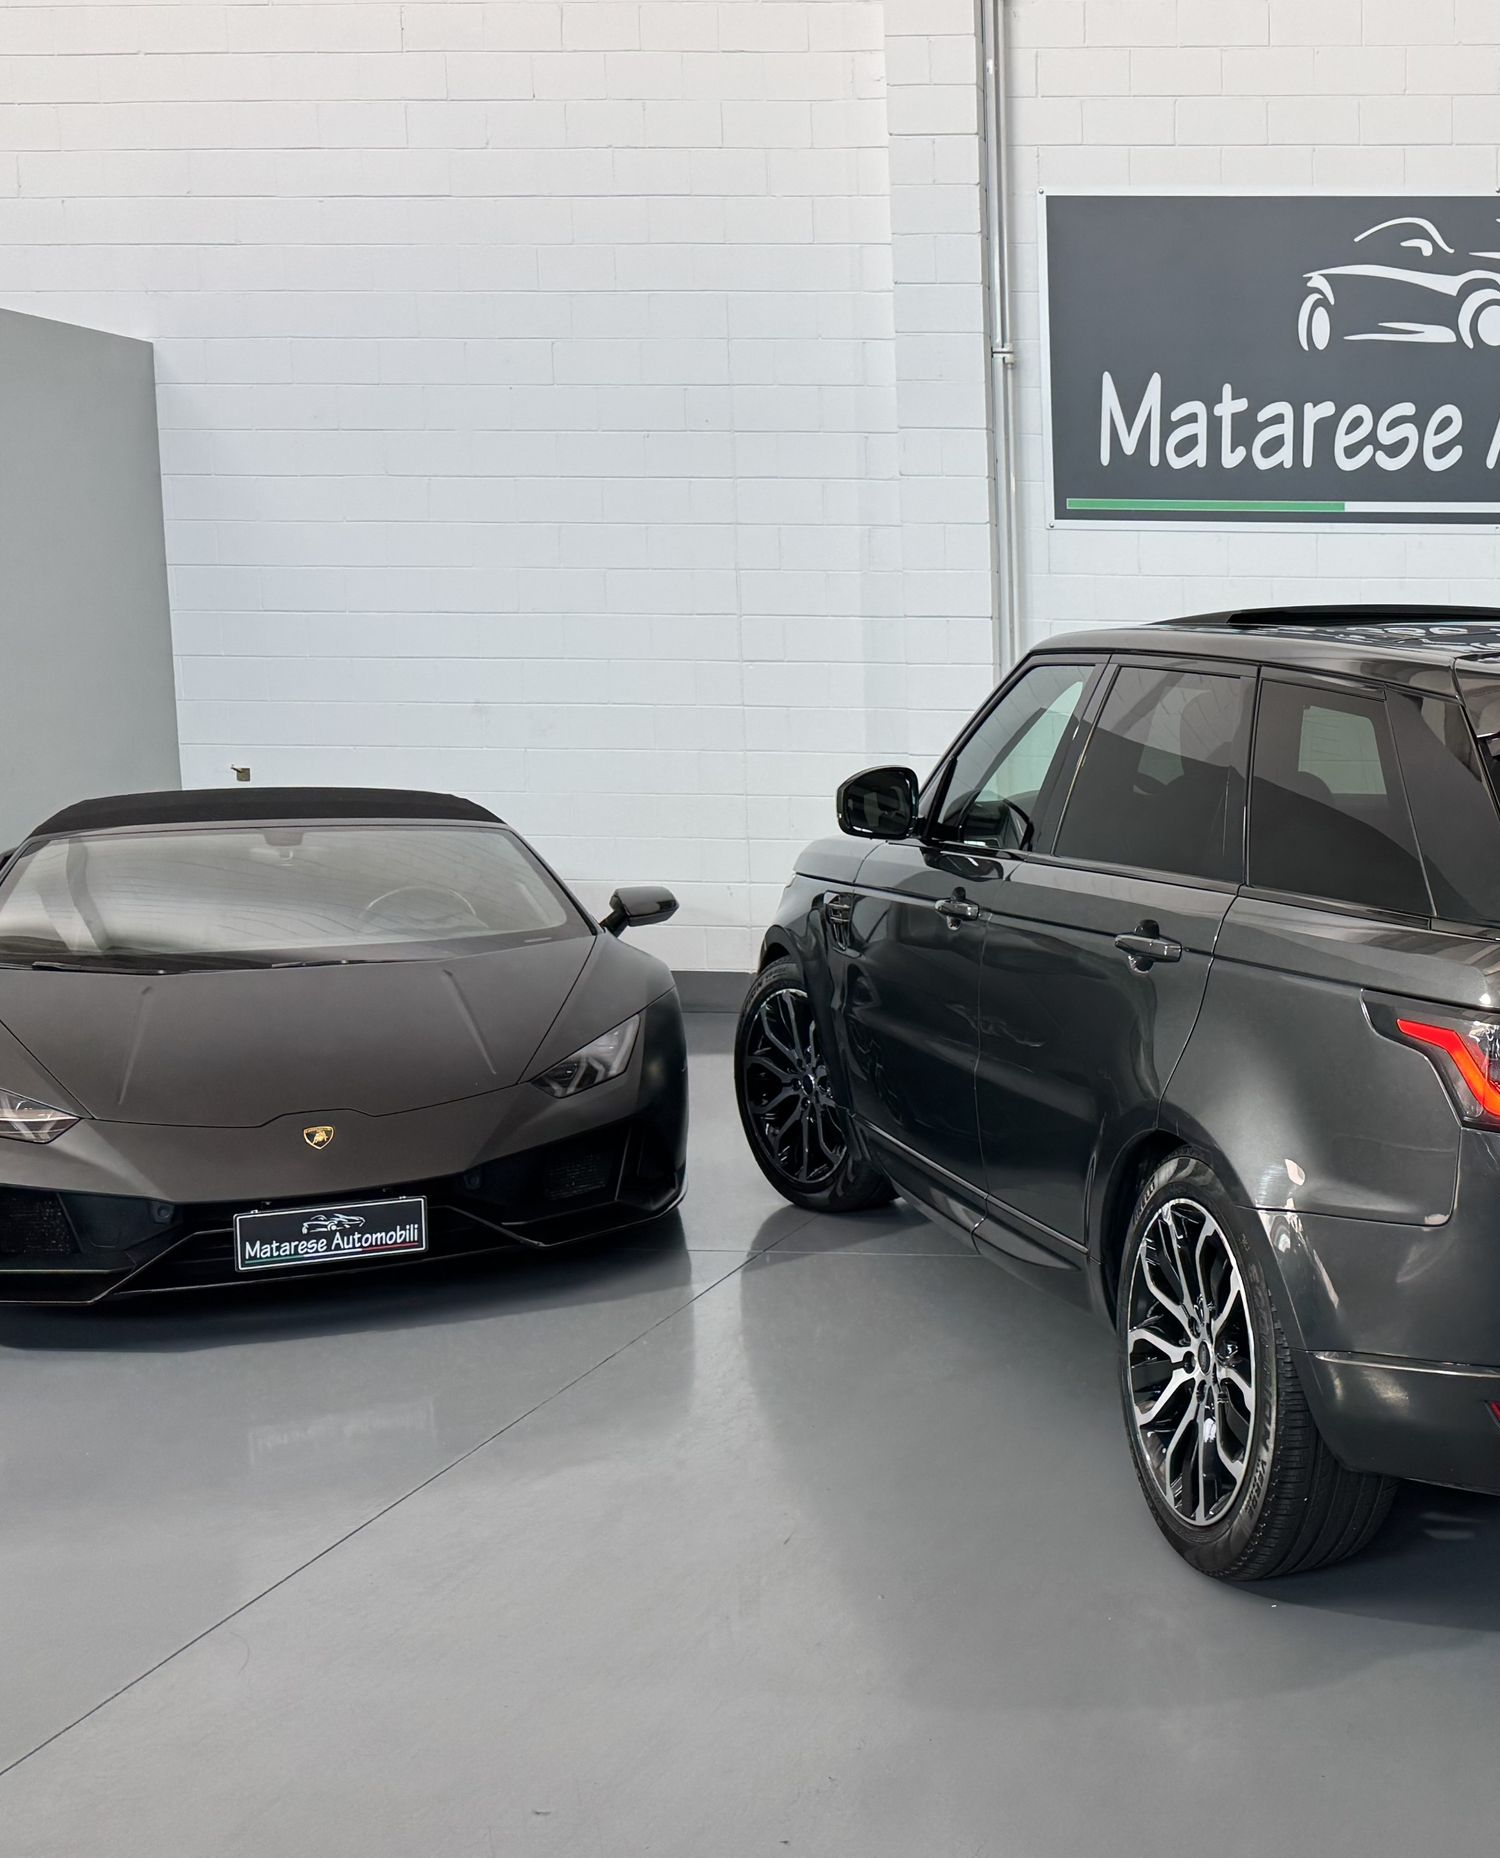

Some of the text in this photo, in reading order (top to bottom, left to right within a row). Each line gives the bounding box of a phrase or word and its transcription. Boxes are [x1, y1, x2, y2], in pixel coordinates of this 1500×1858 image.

[1100, 371, 1463, 472] Matarese
[245, 1224, 419, 1259] Matarese Automobili
